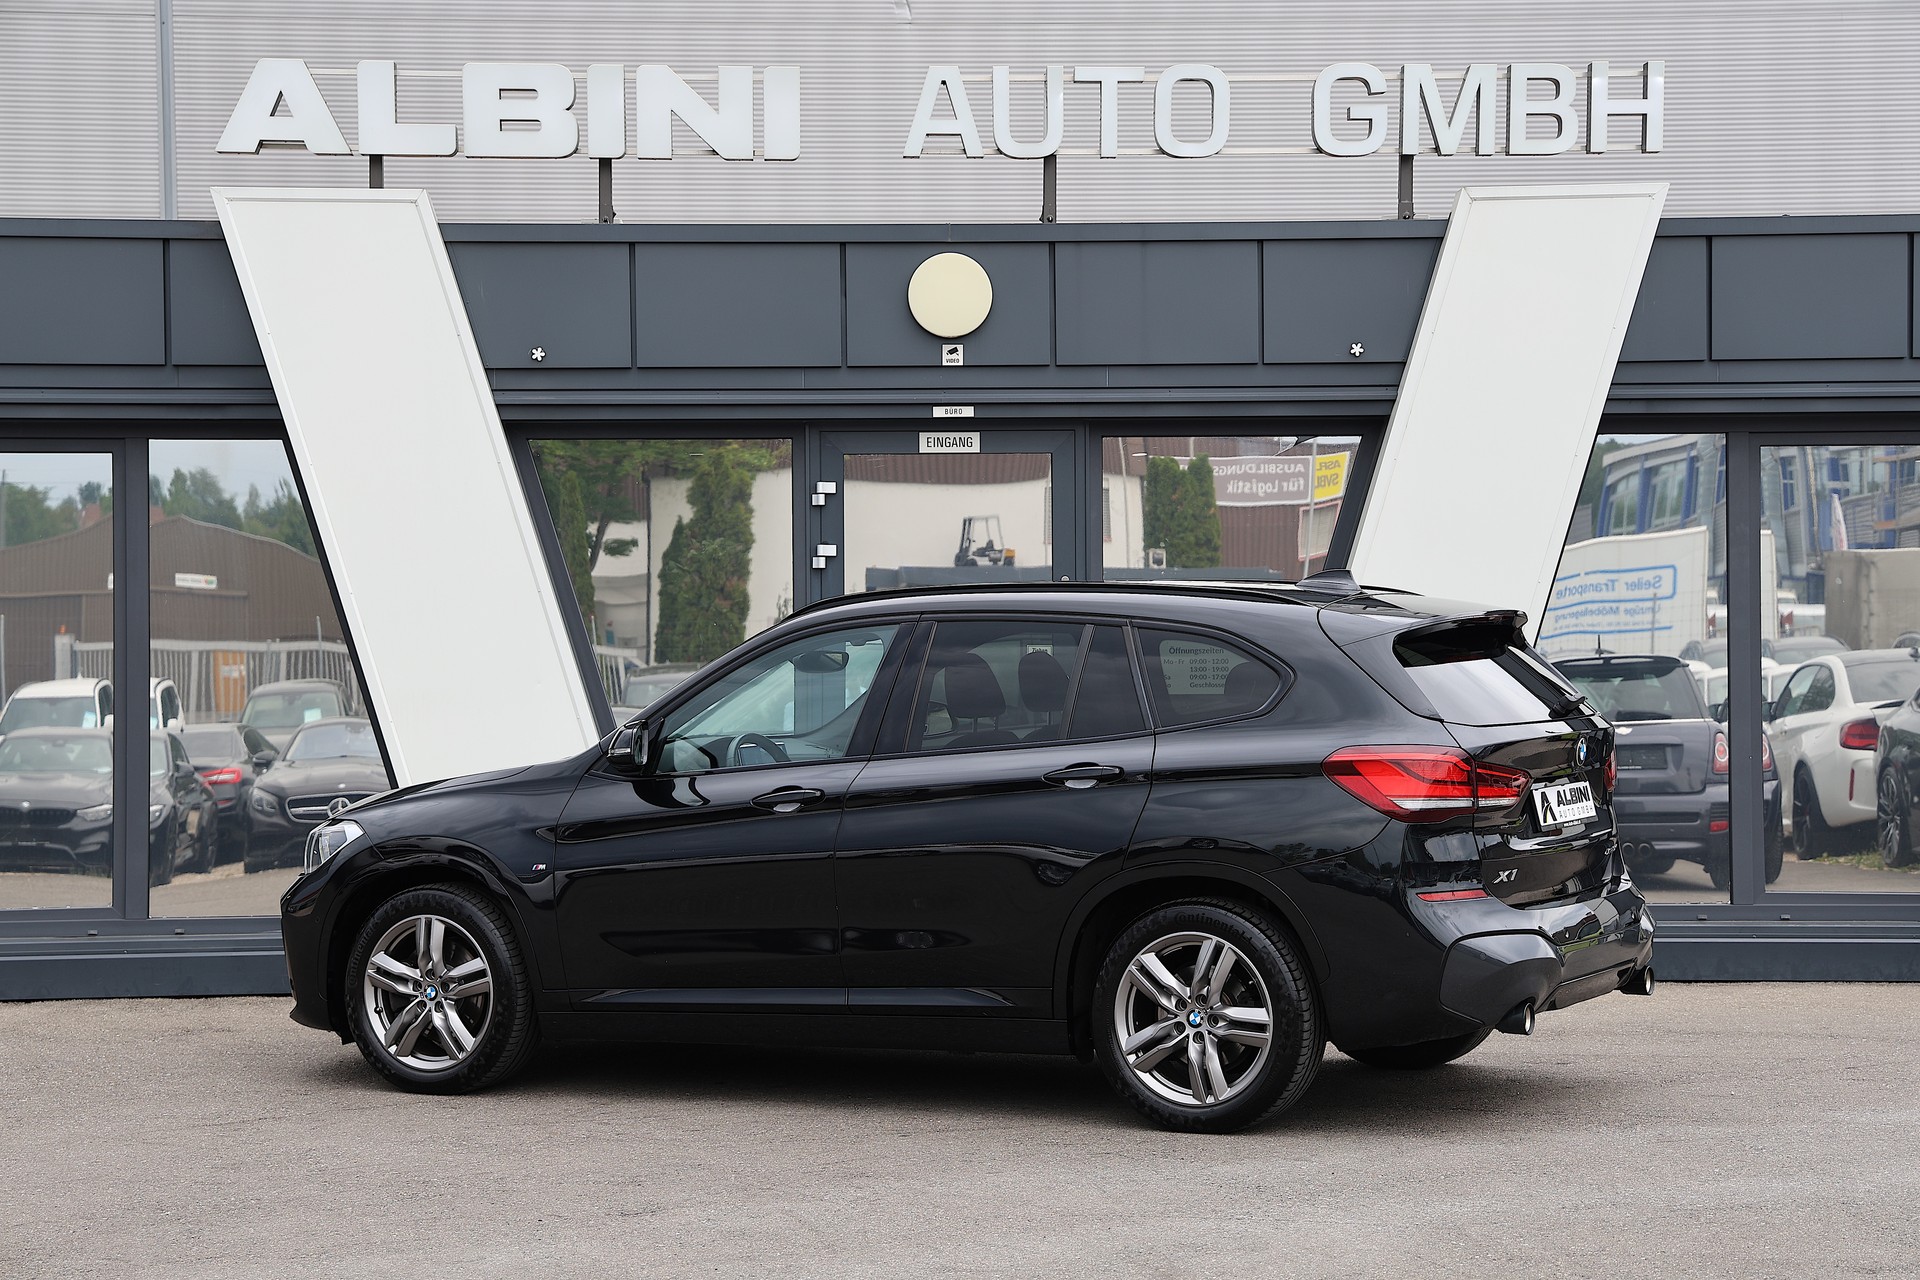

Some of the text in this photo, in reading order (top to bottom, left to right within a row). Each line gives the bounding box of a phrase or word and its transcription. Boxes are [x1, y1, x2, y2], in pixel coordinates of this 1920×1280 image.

[215, 58, 1666, 161] ALBINI AUTO GMBH
[944, 406, 963, 415] BÜRO
[926, 436, 973, 448] EINGANG
[1169, 646, 1224, 655] Öffnungszeiten
[1557, 785, 1590, 807] ALBINI
[1559, 808, 1575, 818] AUTO
[1491, 868, 1518, 884] X1
